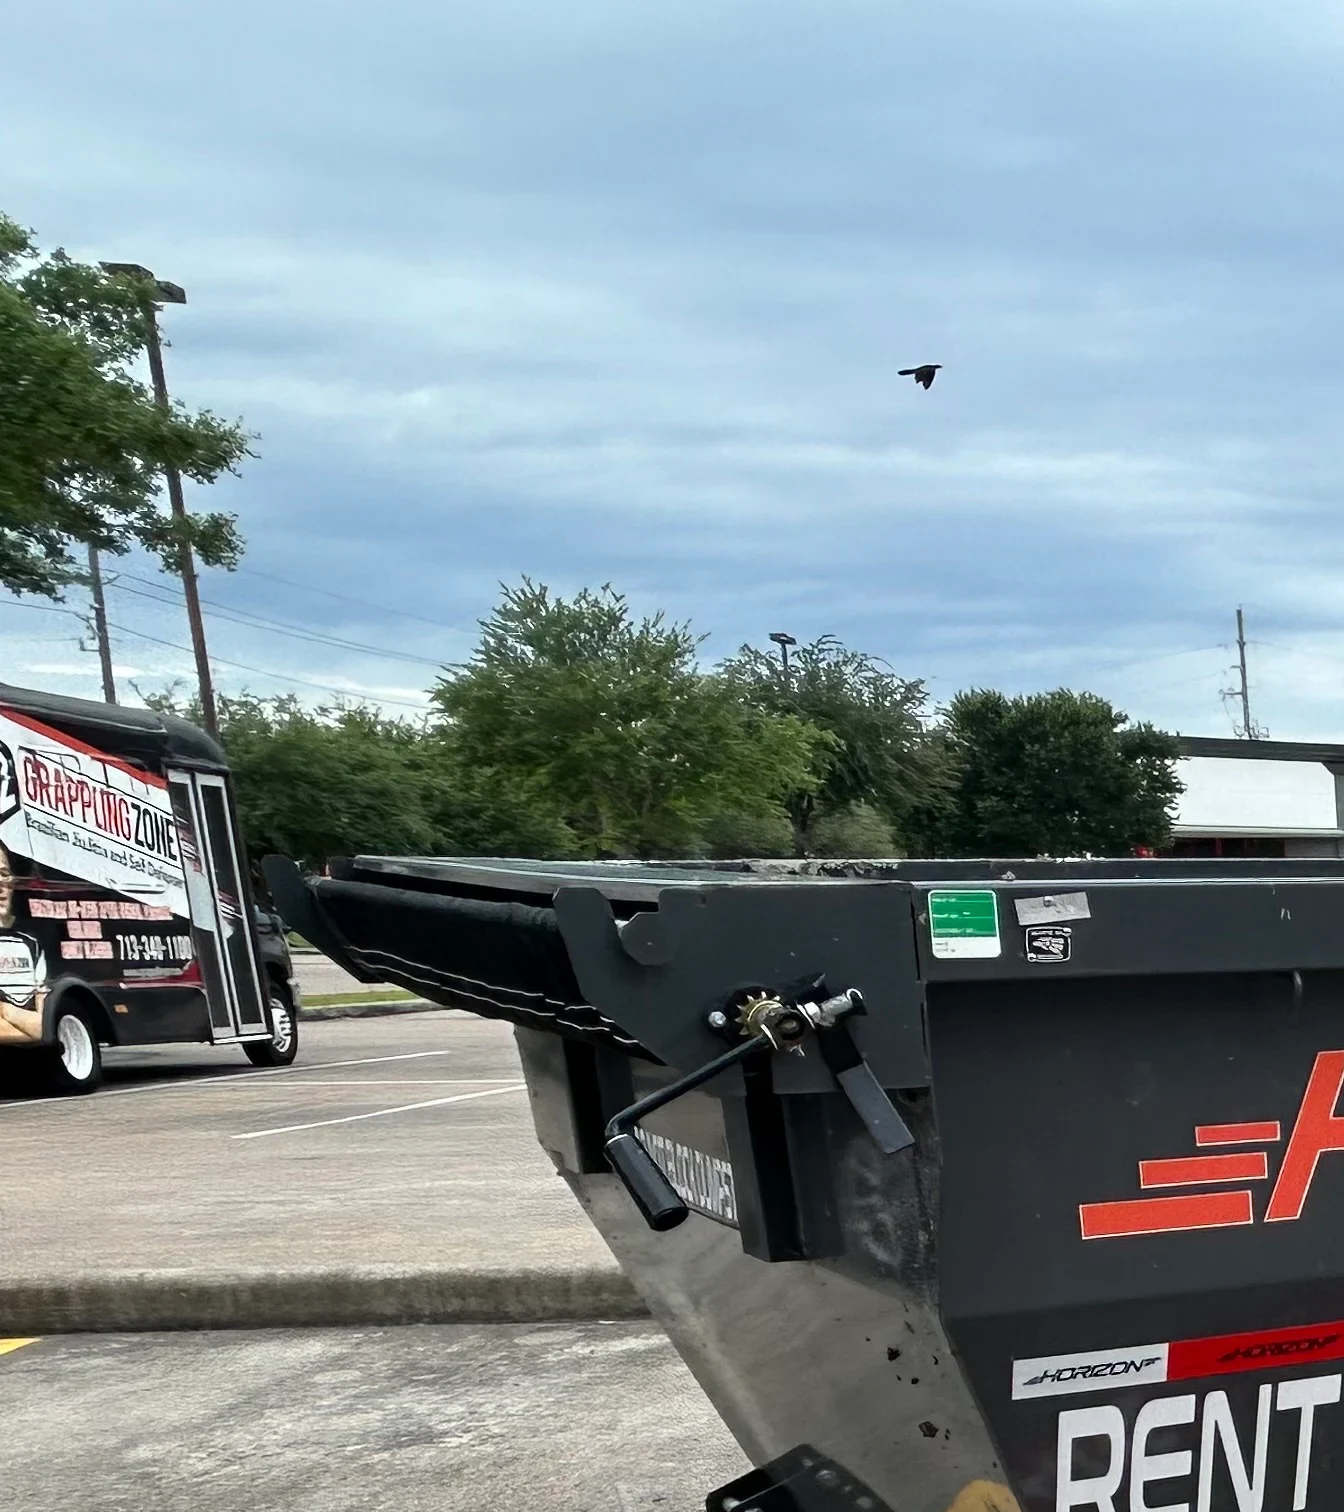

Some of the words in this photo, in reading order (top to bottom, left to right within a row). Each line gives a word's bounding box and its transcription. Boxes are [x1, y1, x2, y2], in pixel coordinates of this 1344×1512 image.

[23, 756, 131, 841] GRAPPLING
[131, 802, 178, 862] ZONE
[1023, 1357, 1161, 1386] HORIZON
